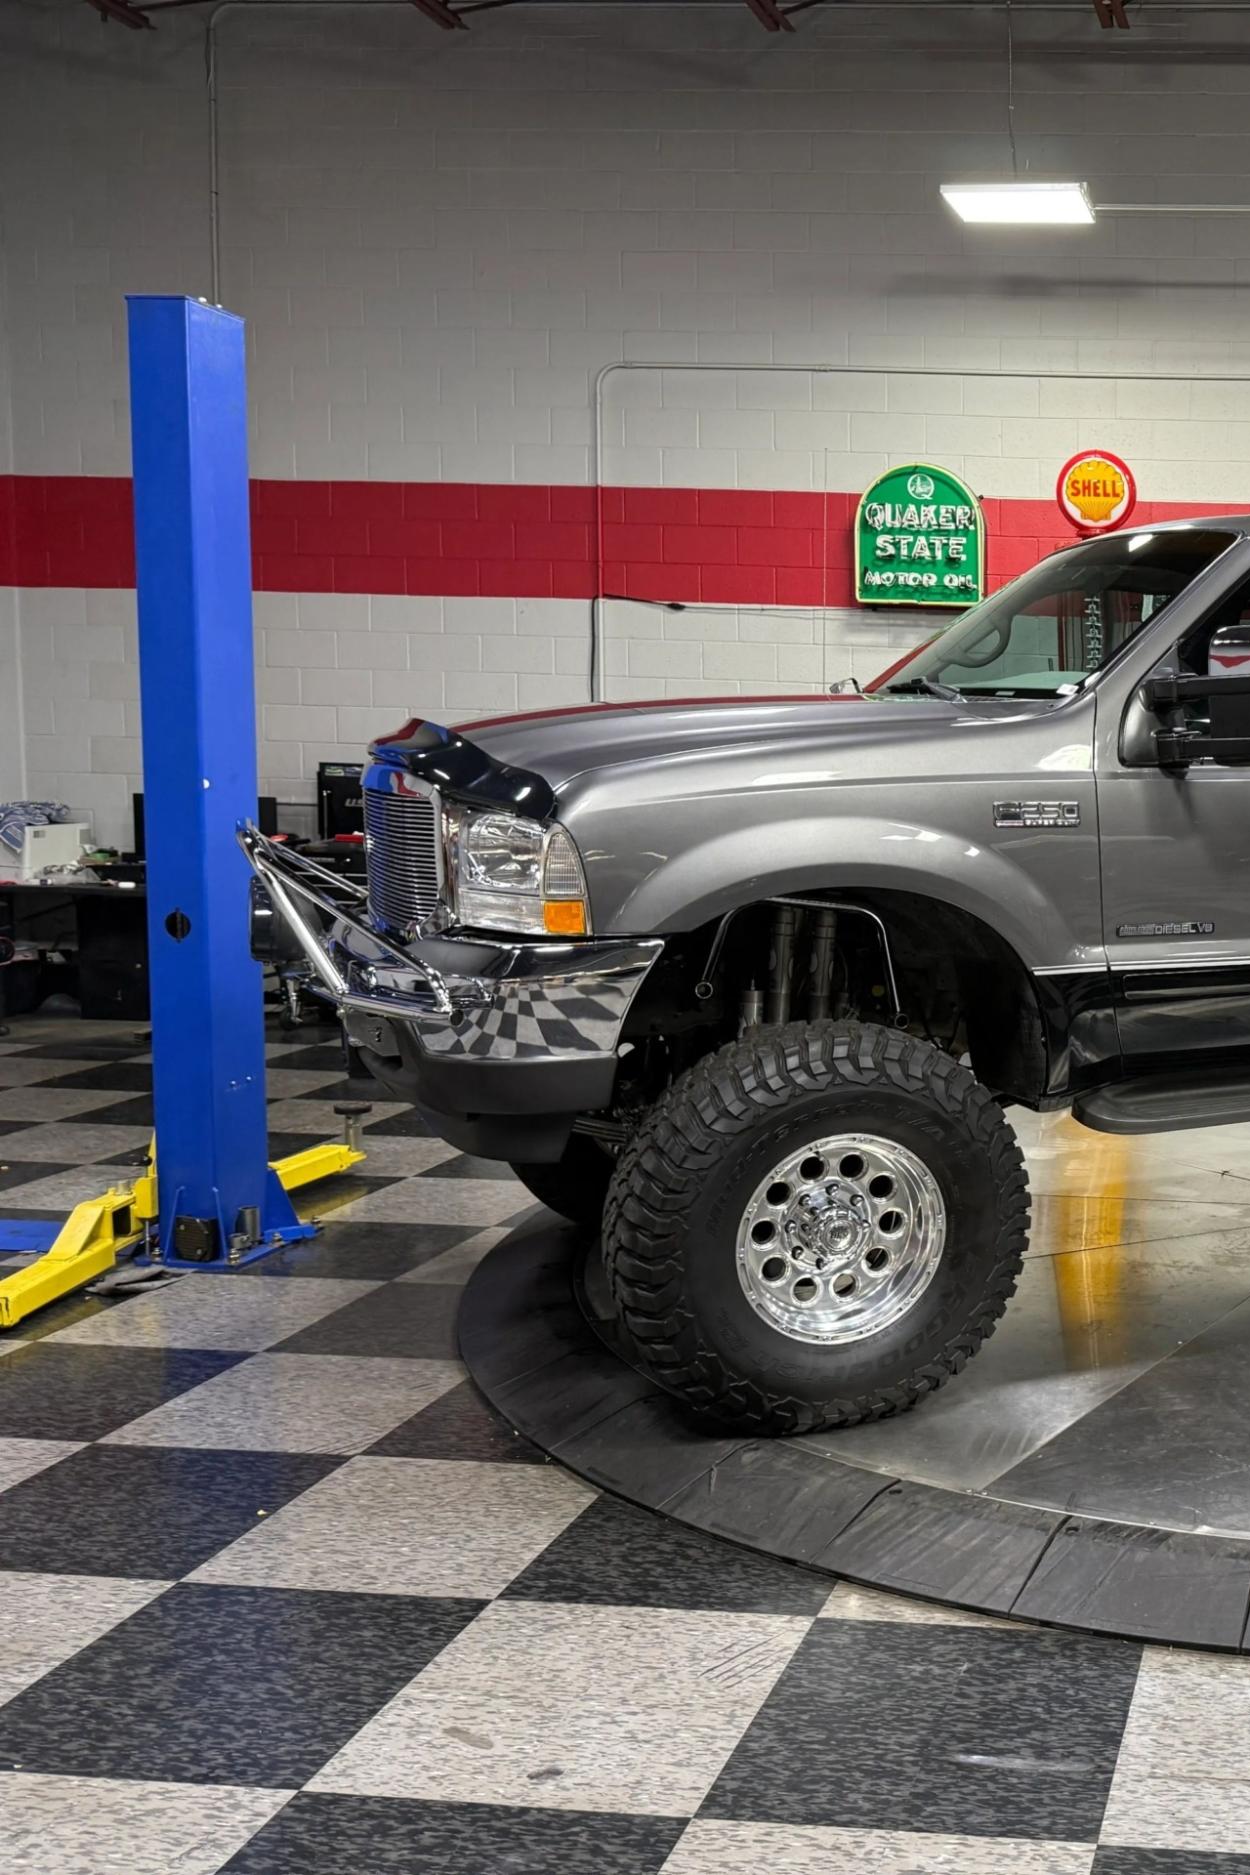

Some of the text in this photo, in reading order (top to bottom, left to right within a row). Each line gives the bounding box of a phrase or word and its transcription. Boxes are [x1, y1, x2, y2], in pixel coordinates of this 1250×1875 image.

[1070, 480, 1121, 499] SHELL
[865, 502, 976, 531] QUAKER
[875, 534, 967, 561] STATE
[864, 570, 977, 589] MOTOR OIL
